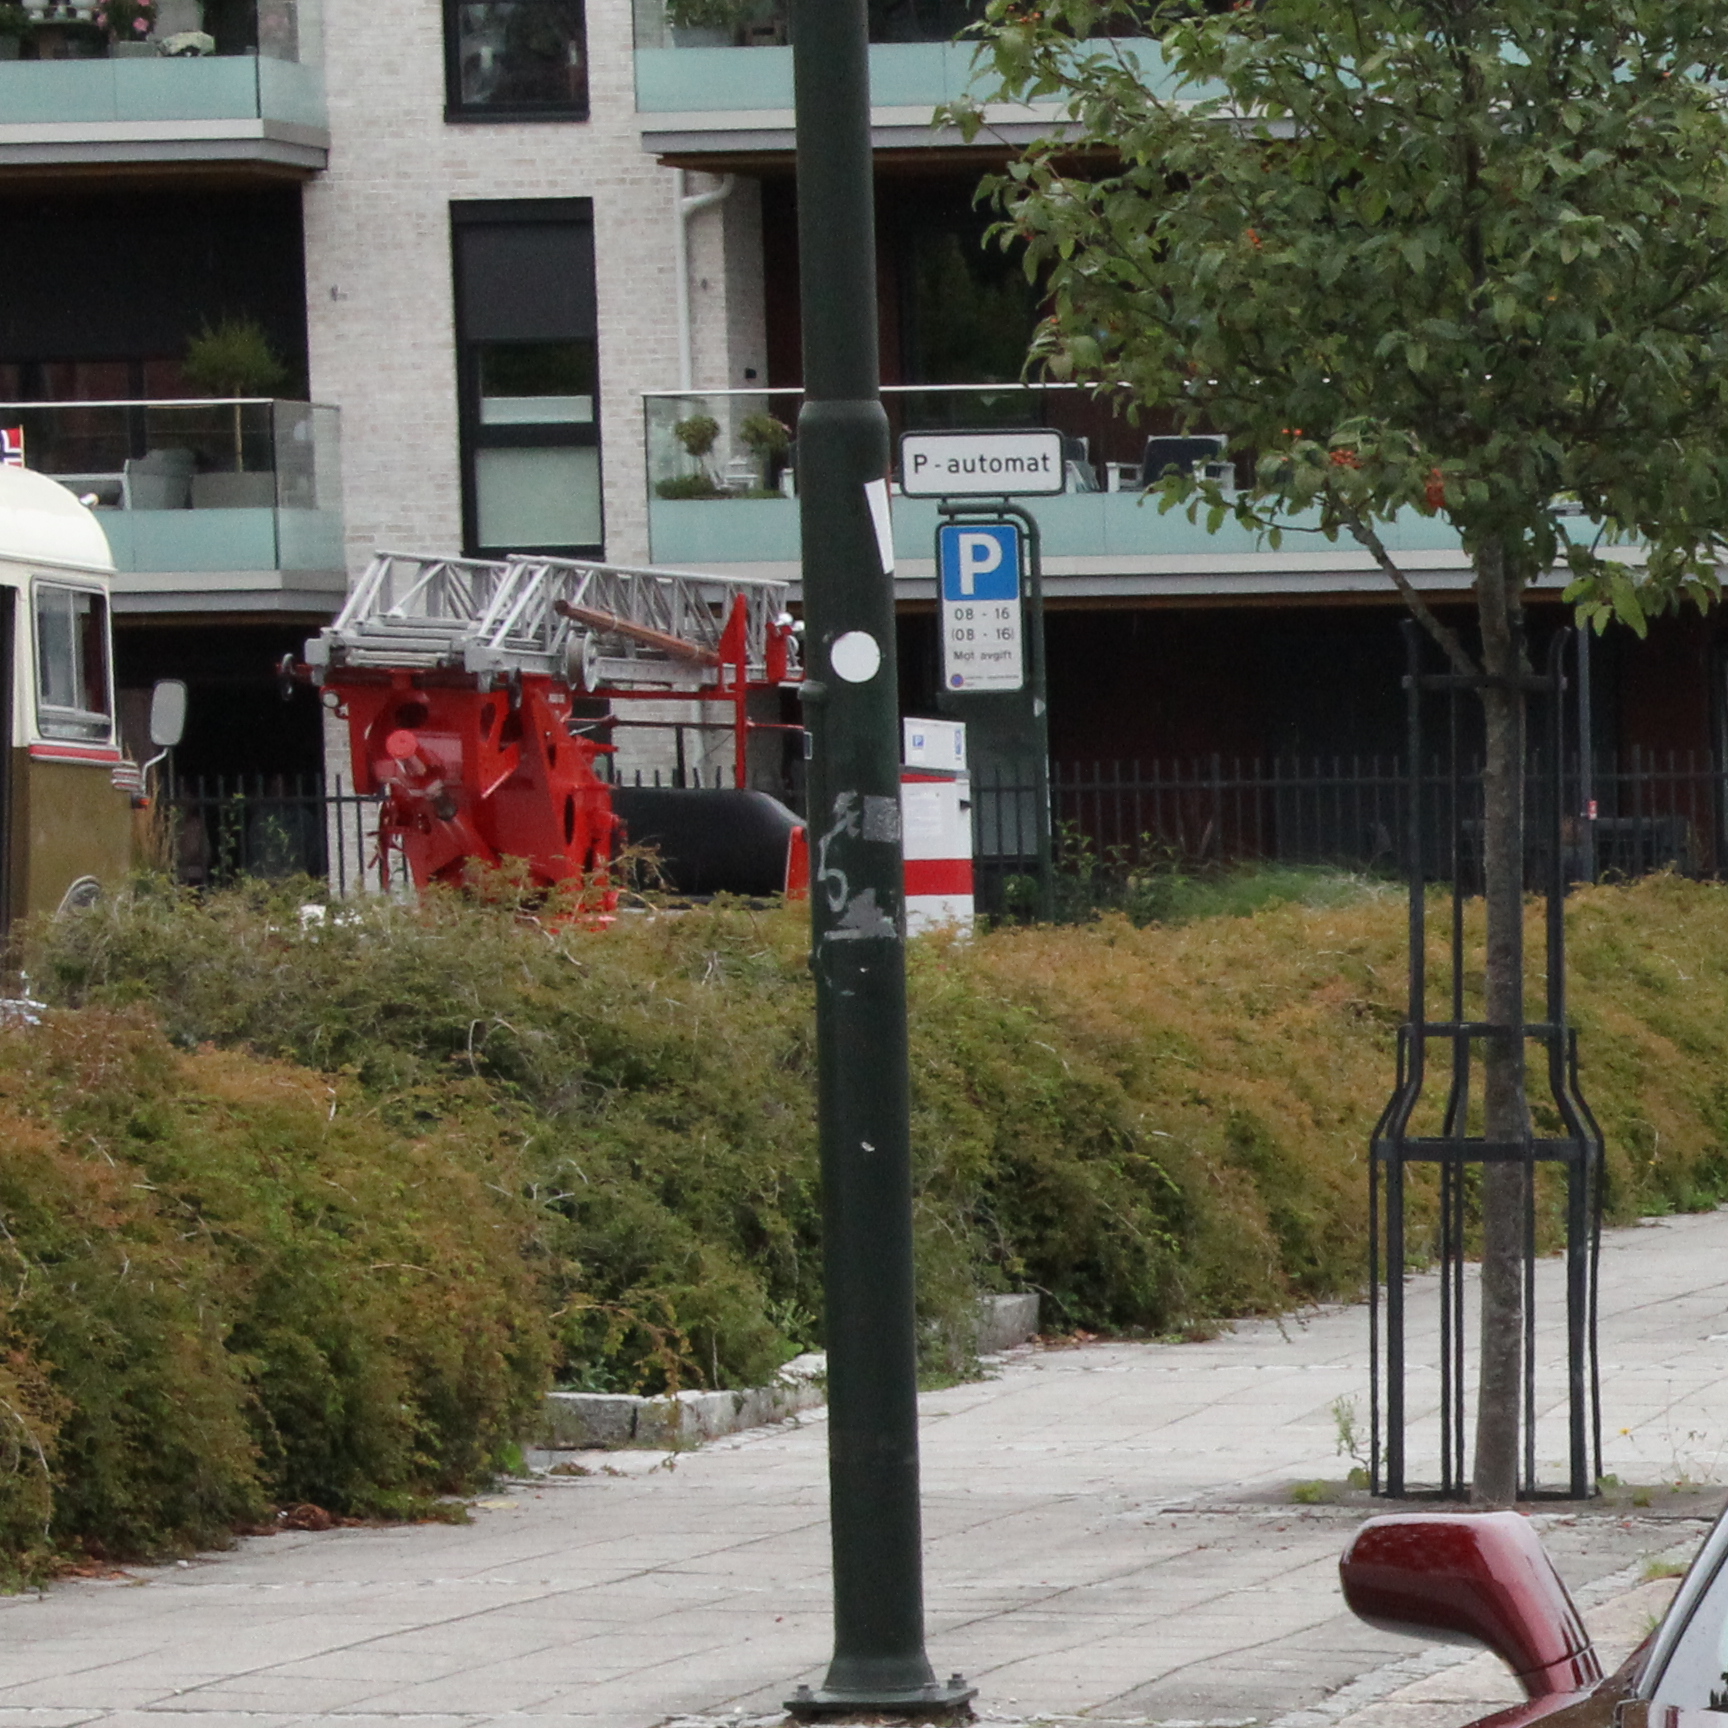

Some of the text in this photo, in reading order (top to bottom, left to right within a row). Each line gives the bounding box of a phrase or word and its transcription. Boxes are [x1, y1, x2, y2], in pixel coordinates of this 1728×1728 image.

[958, 533, 1003, 596] P
[954, 608, 975, 621] 08
[994, 607, 1011, 620] 16
[951, 628, 975, 642] (08
[996, 628, 1015, 641] 16)
[953, 650, 1013, 663] Mot avgift
